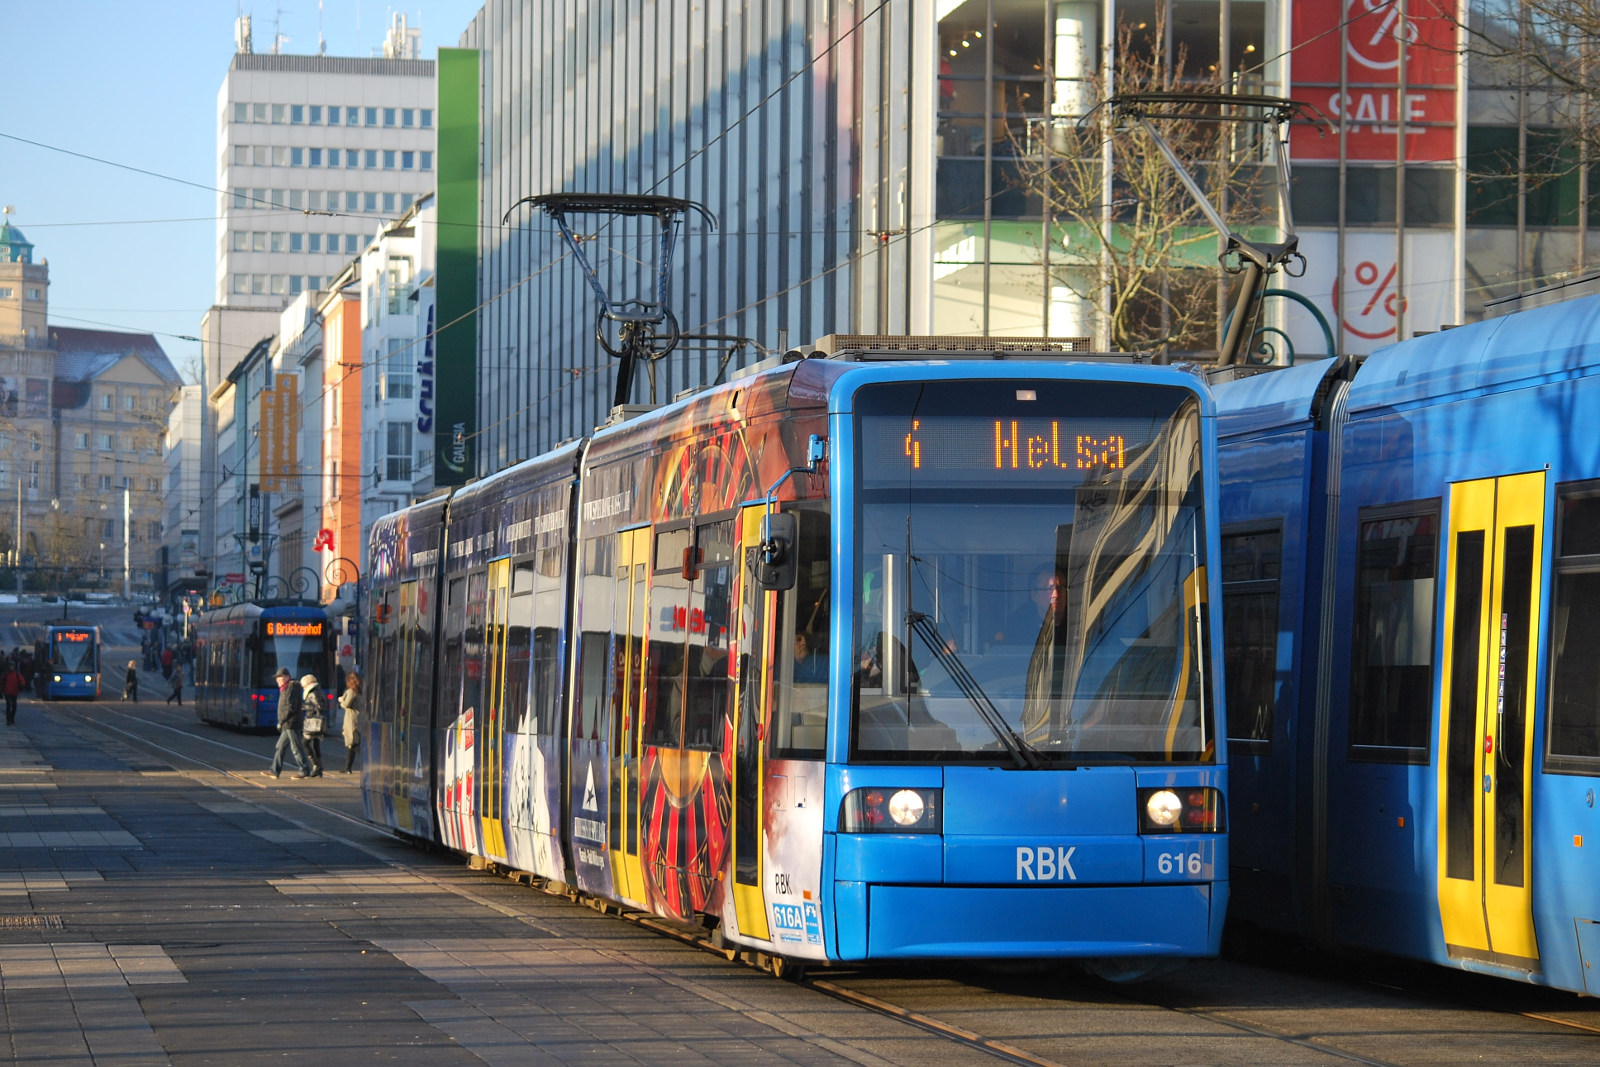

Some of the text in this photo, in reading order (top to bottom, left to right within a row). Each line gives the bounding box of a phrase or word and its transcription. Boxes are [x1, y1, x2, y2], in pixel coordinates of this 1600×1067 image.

[1328, 93, 1427, 135] SALE
[995, 420, 1125, 469] Helsa
[266, 622, 323, 636] 6 Brückenhof
[1015, 846, 1077, 881] RBK
[1157, 852, 1202, 875] 616
[775, 873, 793, 895] RBK
[774, 905, 803, 928] 616A
